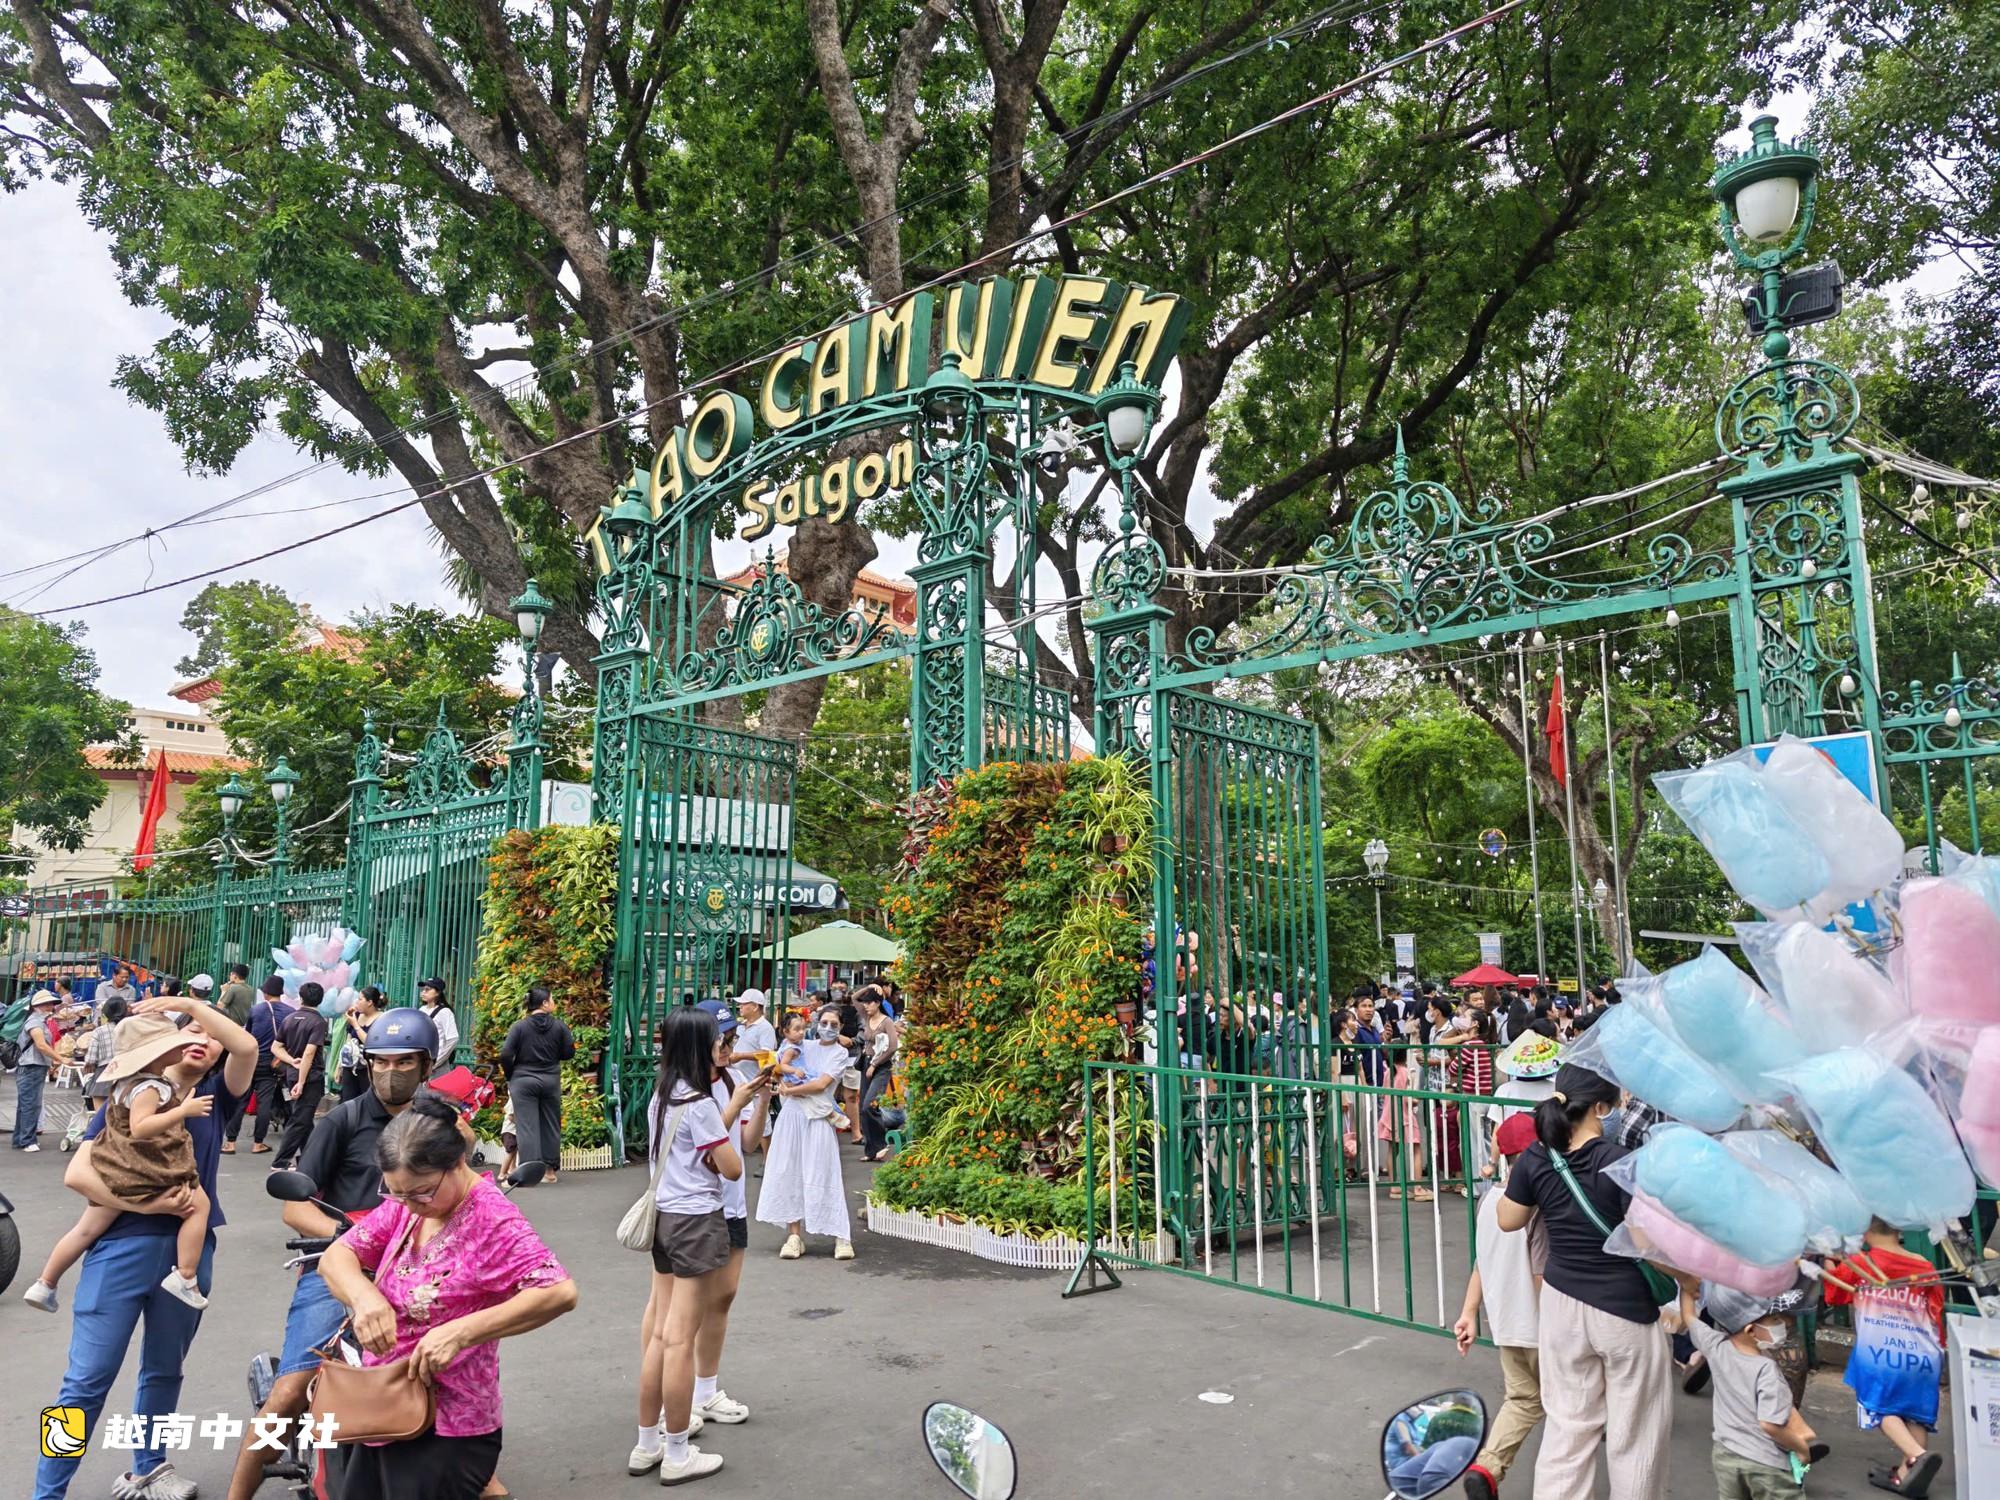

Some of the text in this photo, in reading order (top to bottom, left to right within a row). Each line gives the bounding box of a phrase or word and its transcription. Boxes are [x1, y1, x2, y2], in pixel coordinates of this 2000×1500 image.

[760, 292, 920, 431] CAM
[944, 272, 1183, 397] VIEN
[740, 439, 917, 542] Saigon
[1868, 1345, 1934, 1374] YUPA
[1883, 1336, 1919, 1351] JAN 31
